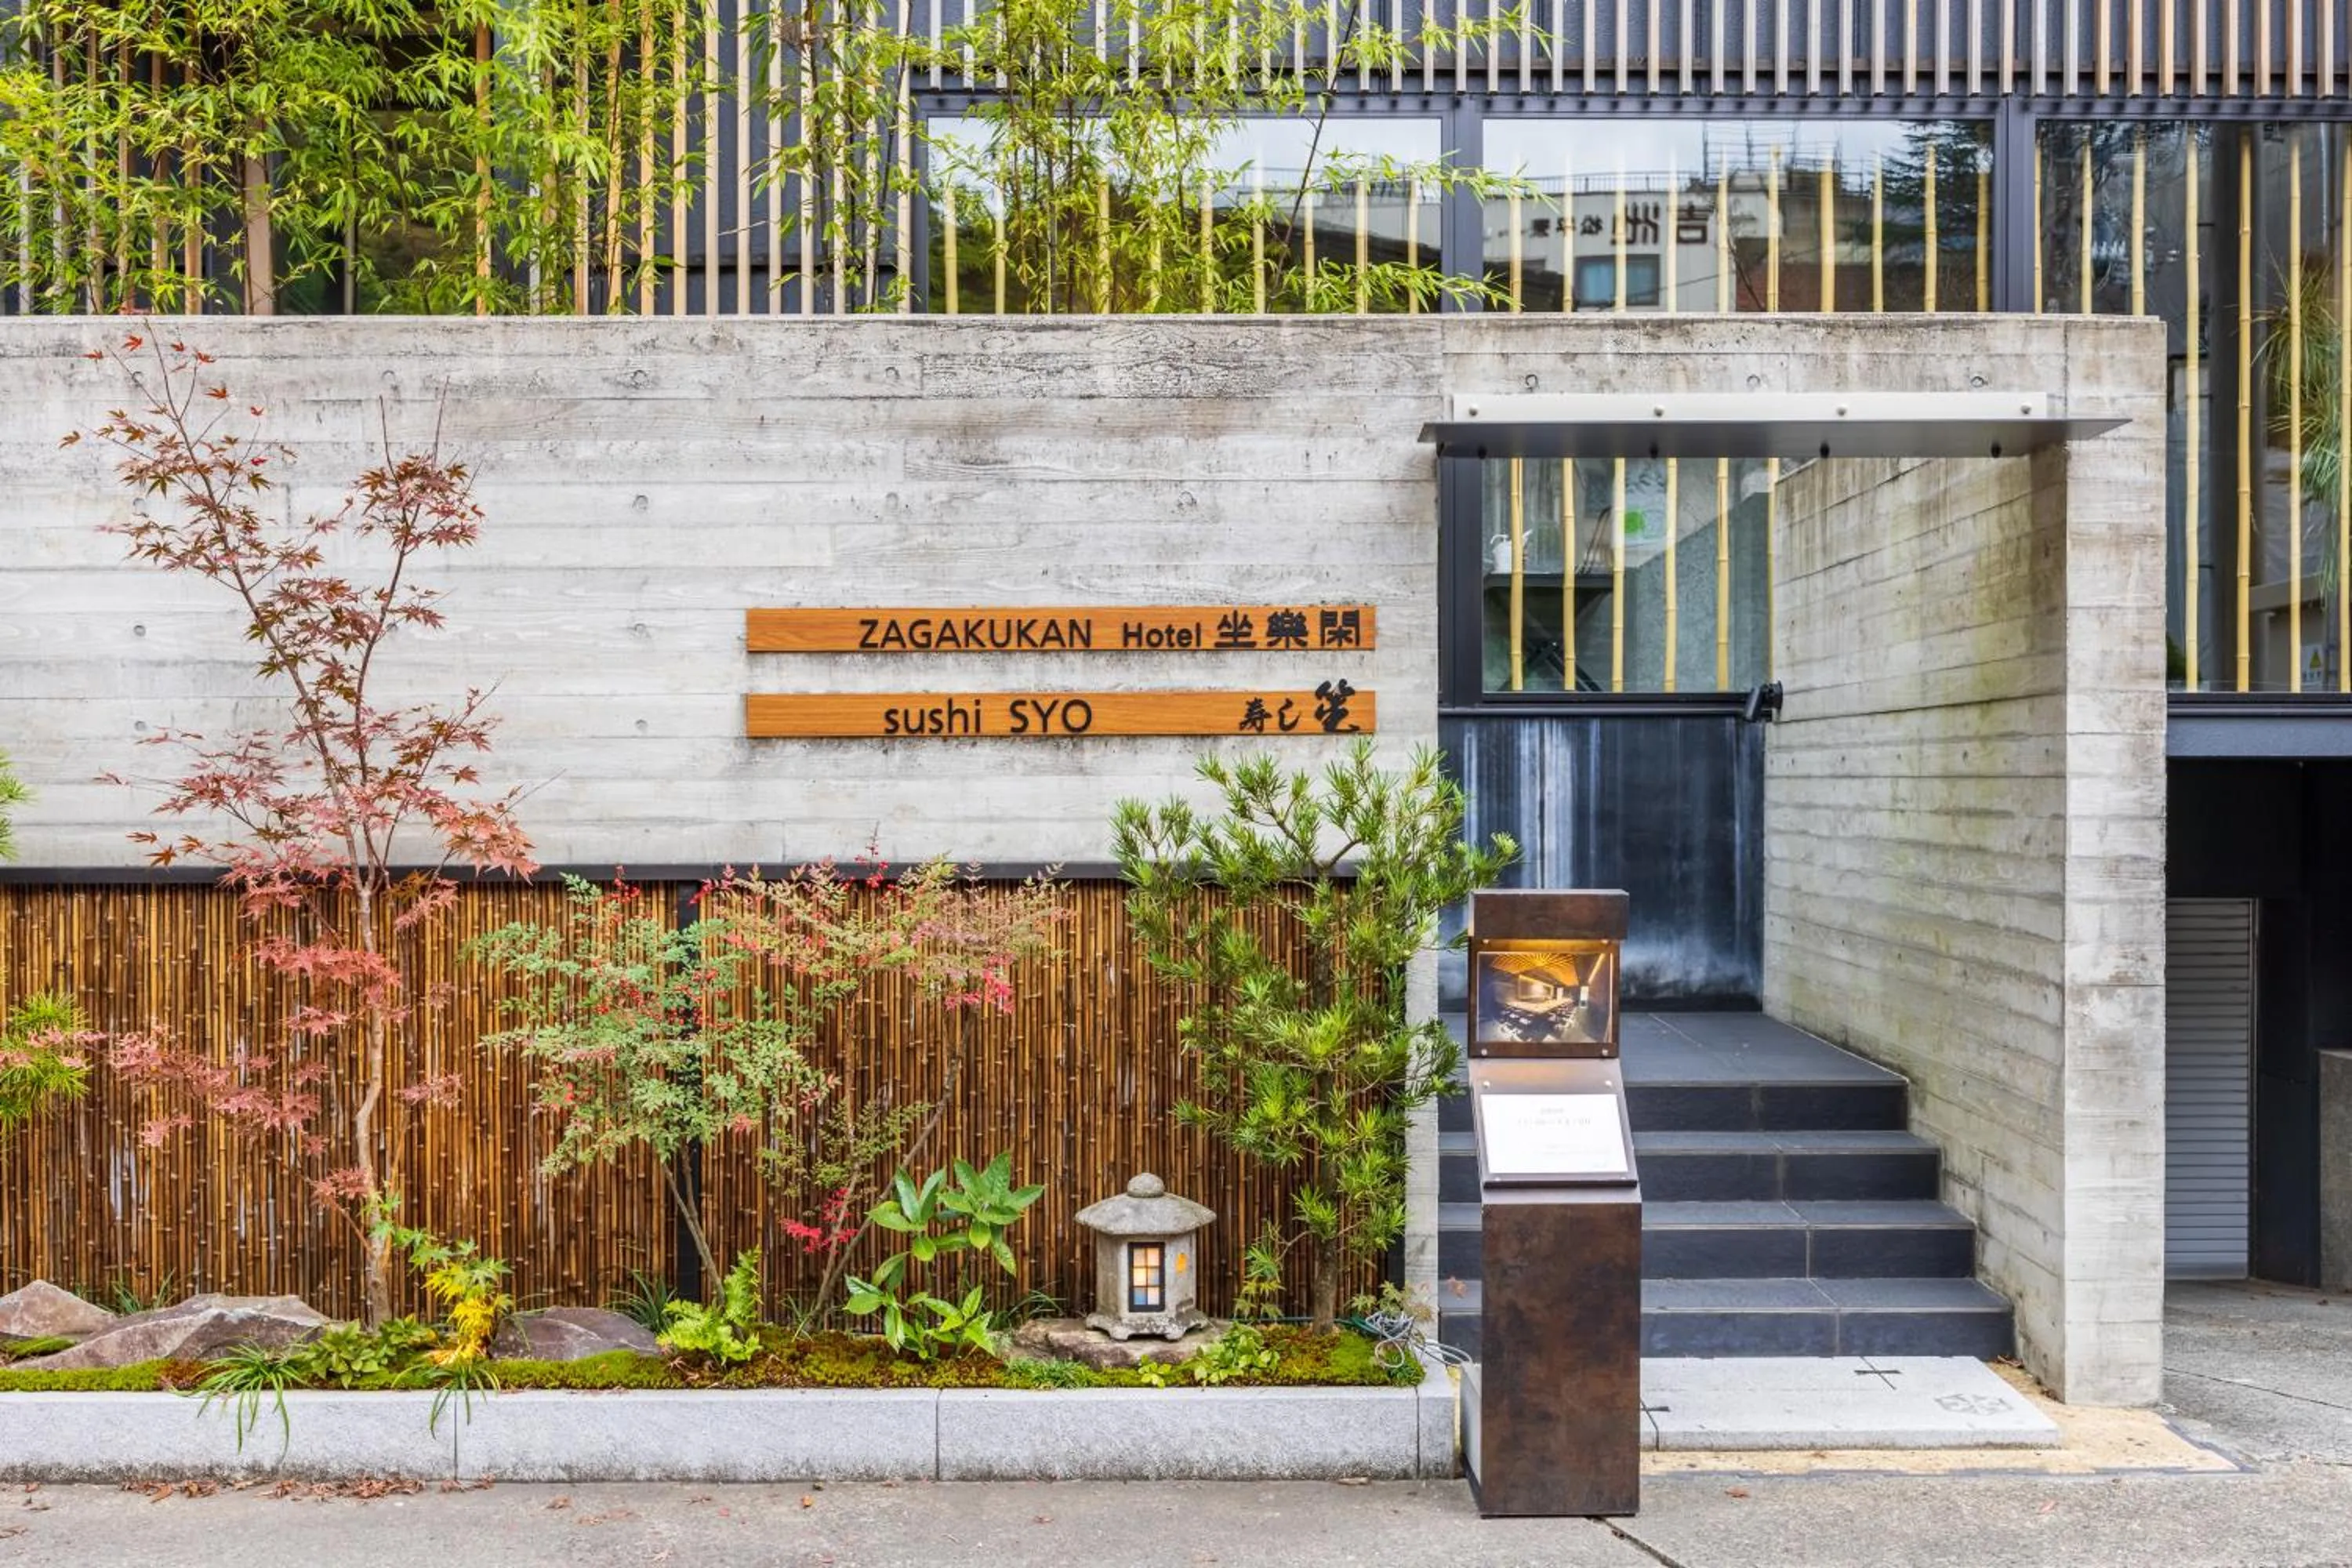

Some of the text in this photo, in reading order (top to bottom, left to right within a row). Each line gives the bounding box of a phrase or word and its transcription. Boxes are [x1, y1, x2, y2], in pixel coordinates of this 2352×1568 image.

[859, 619, 1202, 648] ZAGAKUKAN Hotel
[884, 698, 1092, 734] sushi SYO
